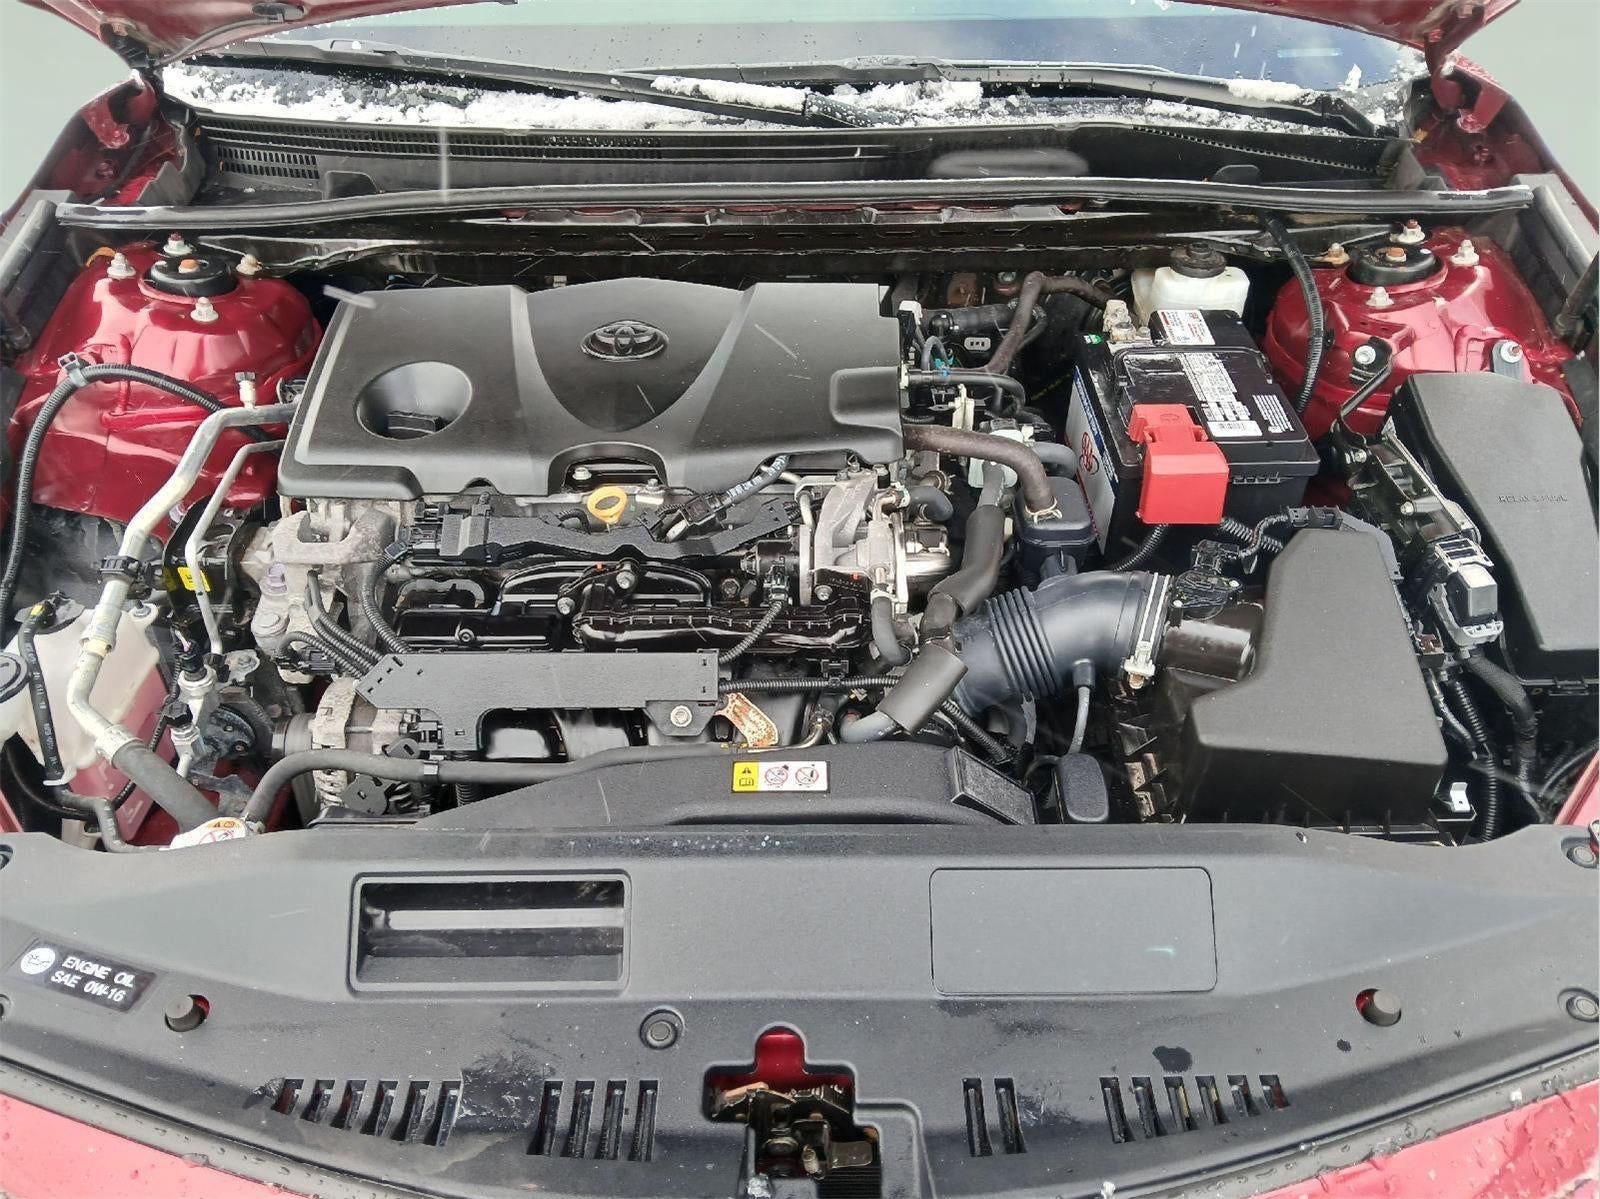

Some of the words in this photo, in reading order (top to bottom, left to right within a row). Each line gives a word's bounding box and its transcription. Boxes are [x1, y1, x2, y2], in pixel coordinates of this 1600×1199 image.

[51, 970, 81, 988] SAE
[84, 981, 126, 1002] 0W-16
[62, 956, 112, 980] ENGINE
[113, 972, 136, 988] OIL
